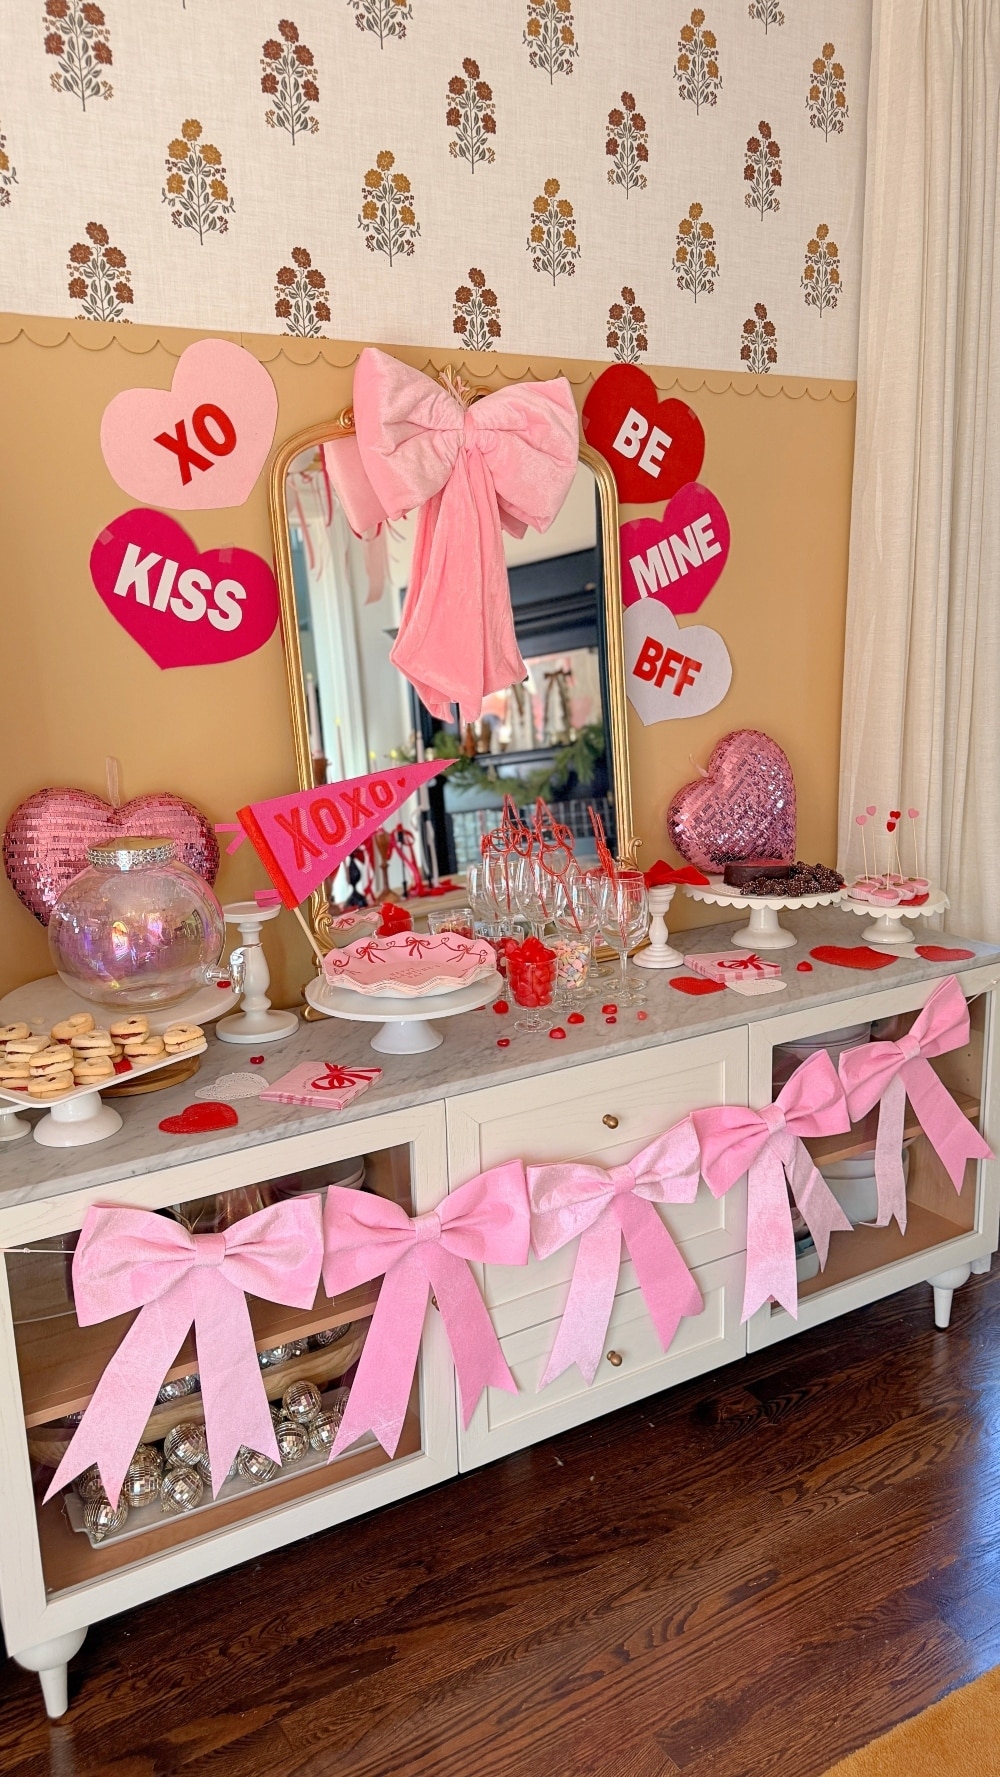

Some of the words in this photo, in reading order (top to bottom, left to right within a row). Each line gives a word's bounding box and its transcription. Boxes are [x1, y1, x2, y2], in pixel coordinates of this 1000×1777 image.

[153, 403, 237, 486] XO
[612, 407, 673, 479] BE
[113, 543, 247, 632] KISS
[629, 512, 722, 598] MINE
[632, 636, 703, 697] BFF
[273, 779, 398, 873] XOXO
